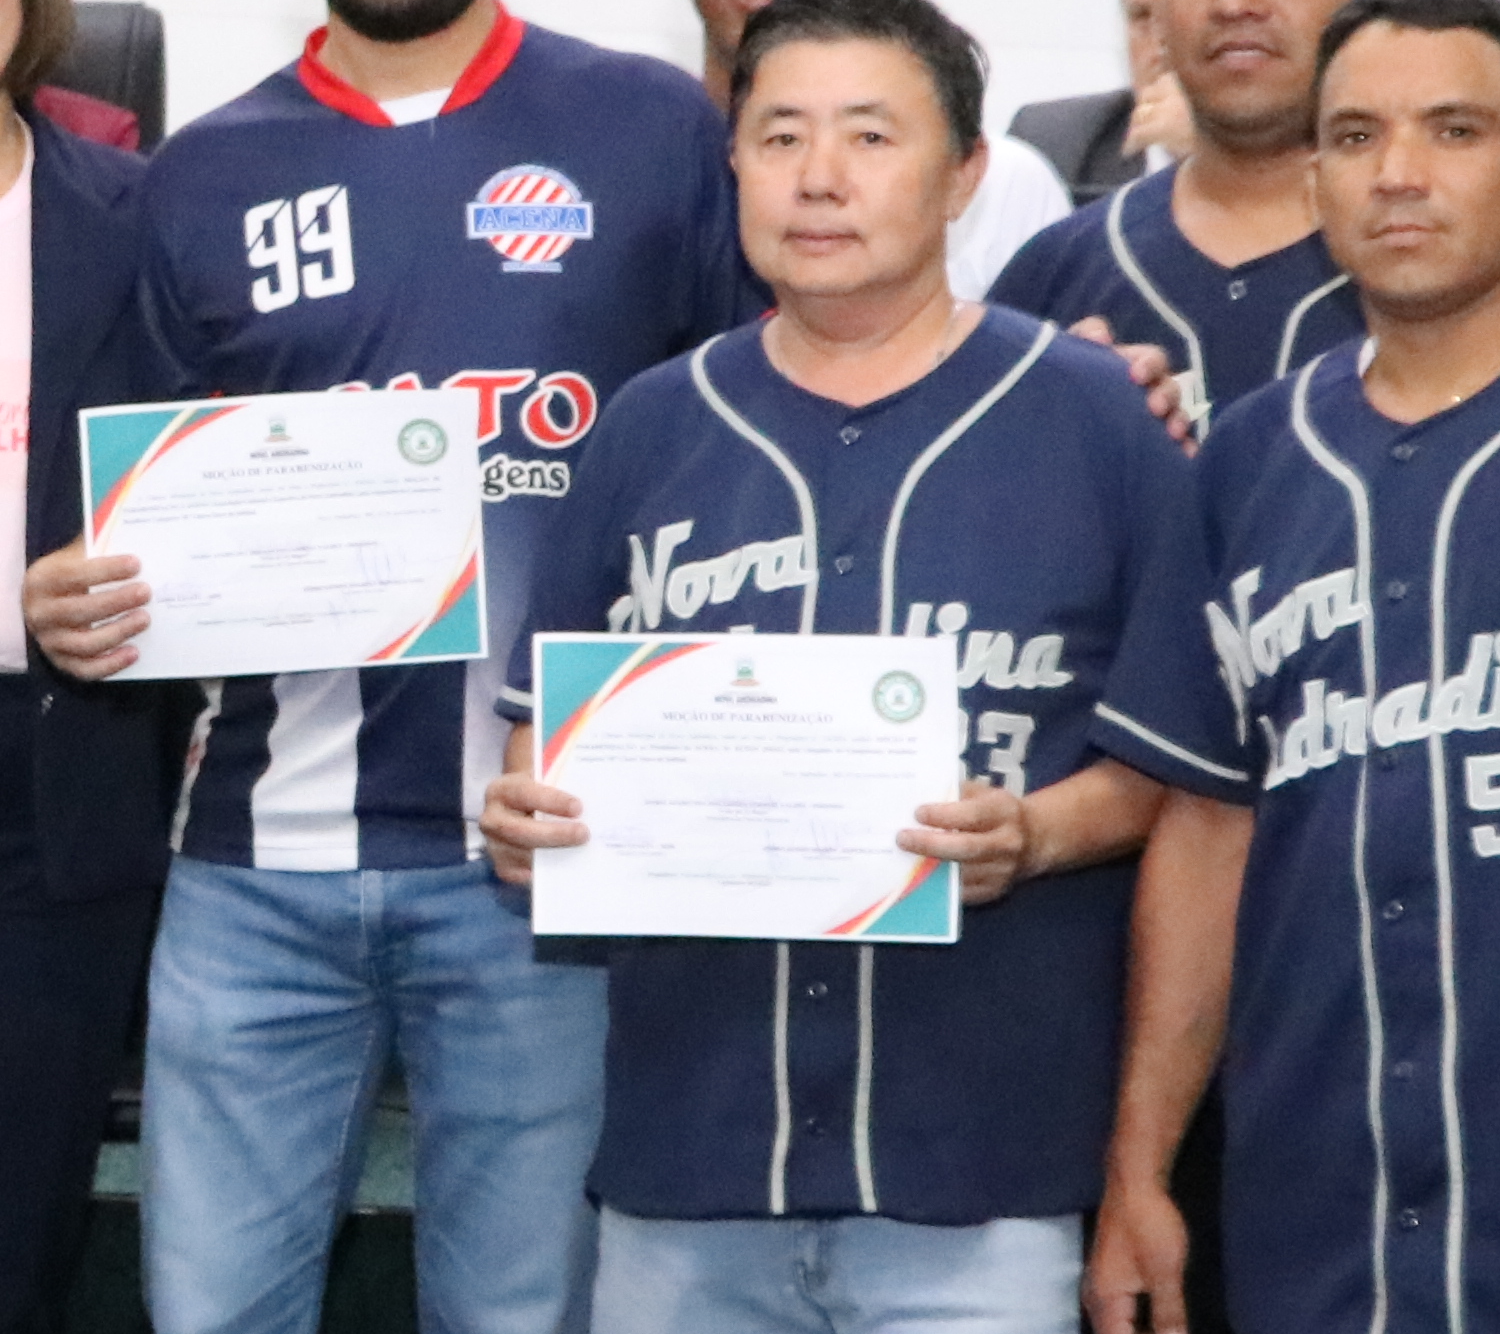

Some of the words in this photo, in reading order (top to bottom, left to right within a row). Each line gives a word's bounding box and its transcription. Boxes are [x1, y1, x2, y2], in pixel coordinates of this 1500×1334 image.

[243, 184, 355, 314] 99
[475, 208, 586, 231] ACENA
[608, 520, 818, 633] Nova
[1206, 567, 1371, 746] Nova
